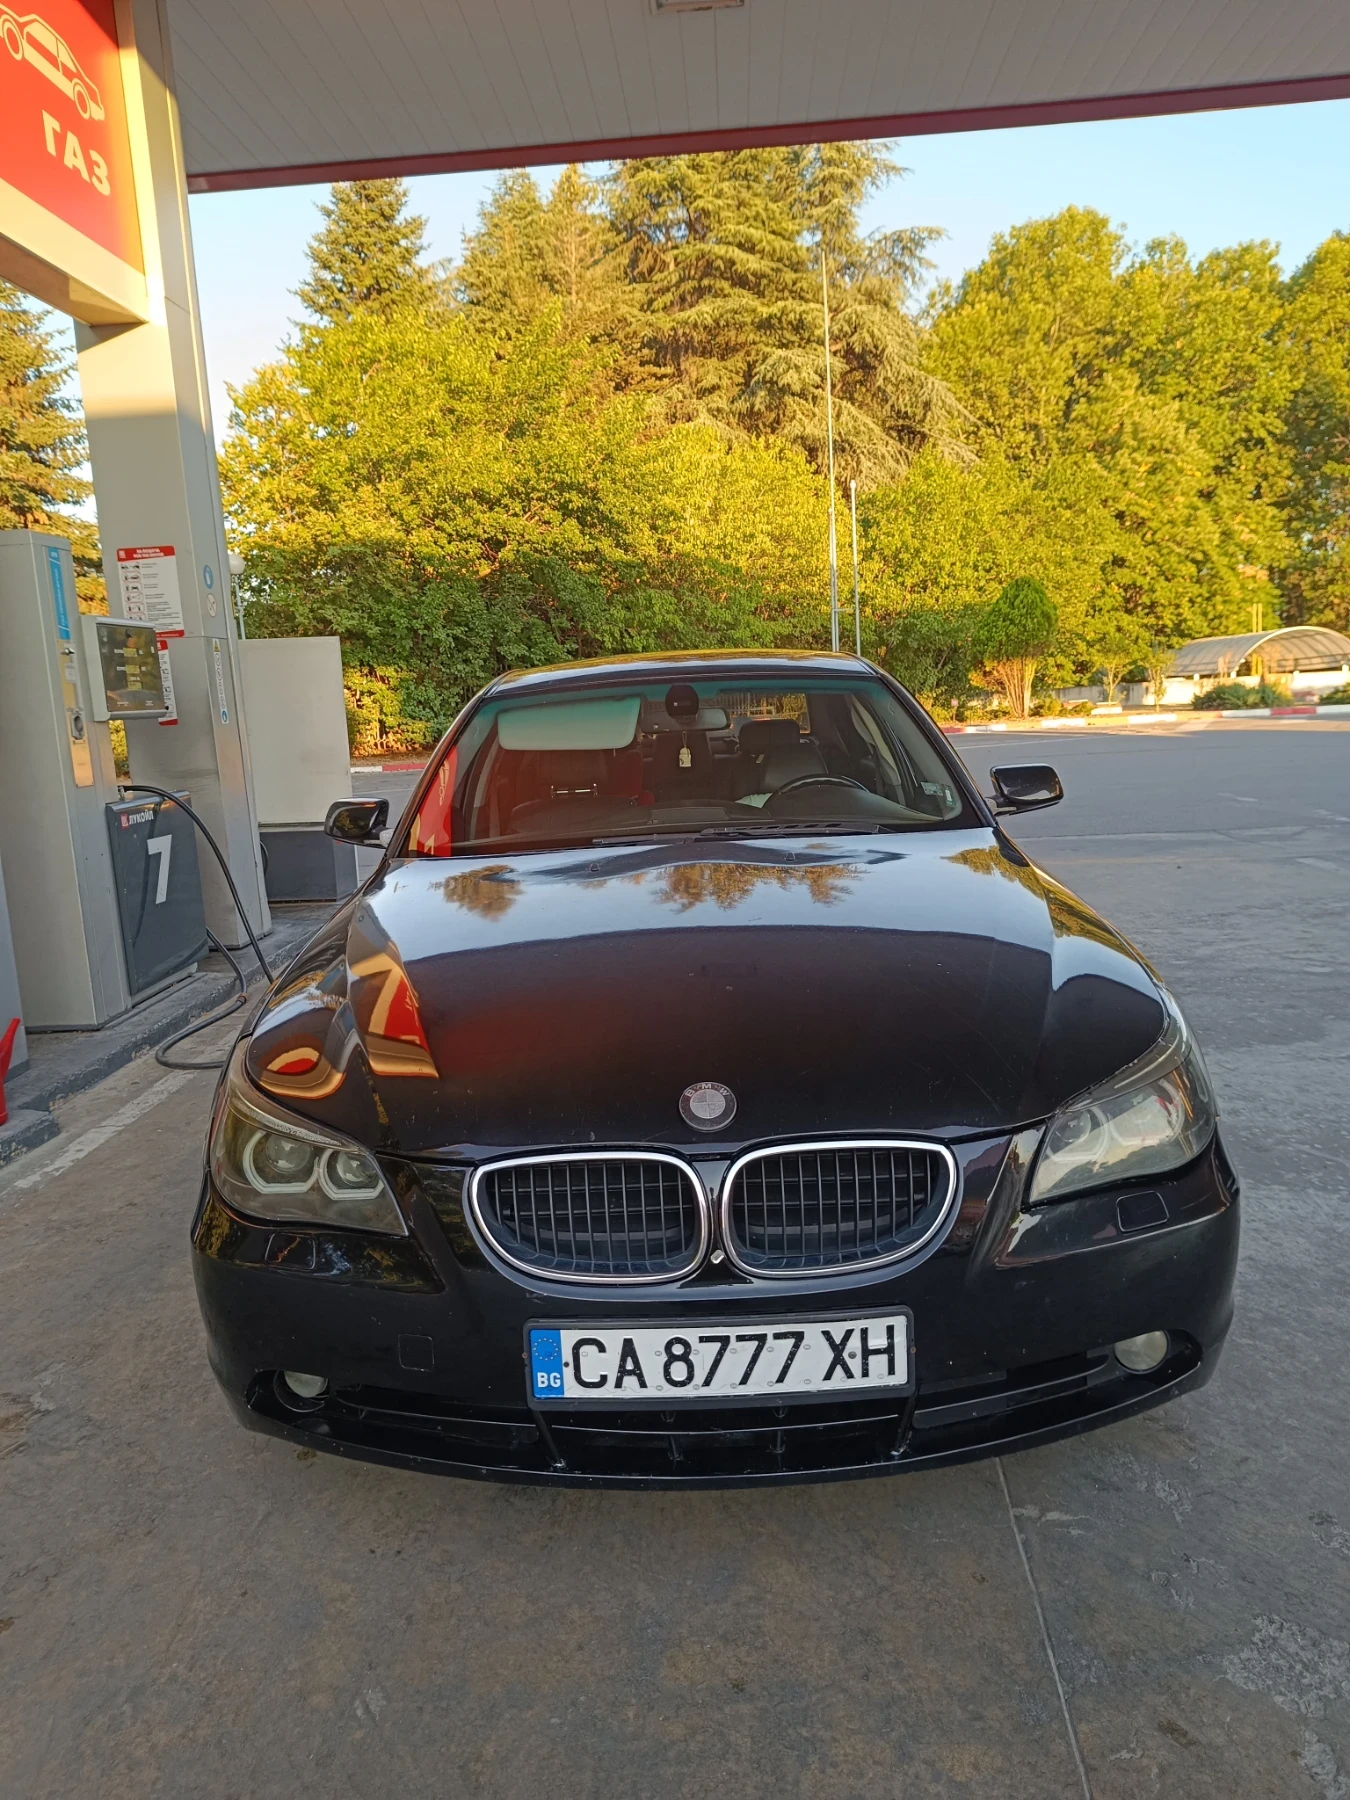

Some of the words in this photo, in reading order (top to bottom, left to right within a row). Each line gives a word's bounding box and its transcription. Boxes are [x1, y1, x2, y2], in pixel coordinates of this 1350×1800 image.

[42, 109, 111, 196] ГАЗ
[129, 809, 154, 825] ЛУКОЙЛ
[147, 834, 172, 904] 7
[685, 1083, 730, 1097] BMW
[571, 1337, 648, 1389] CA
[663, 1331, 805, 1388] 8777
[820, 1324, 896, 1381] XH
[537, 1372, 562, 1388] BG
